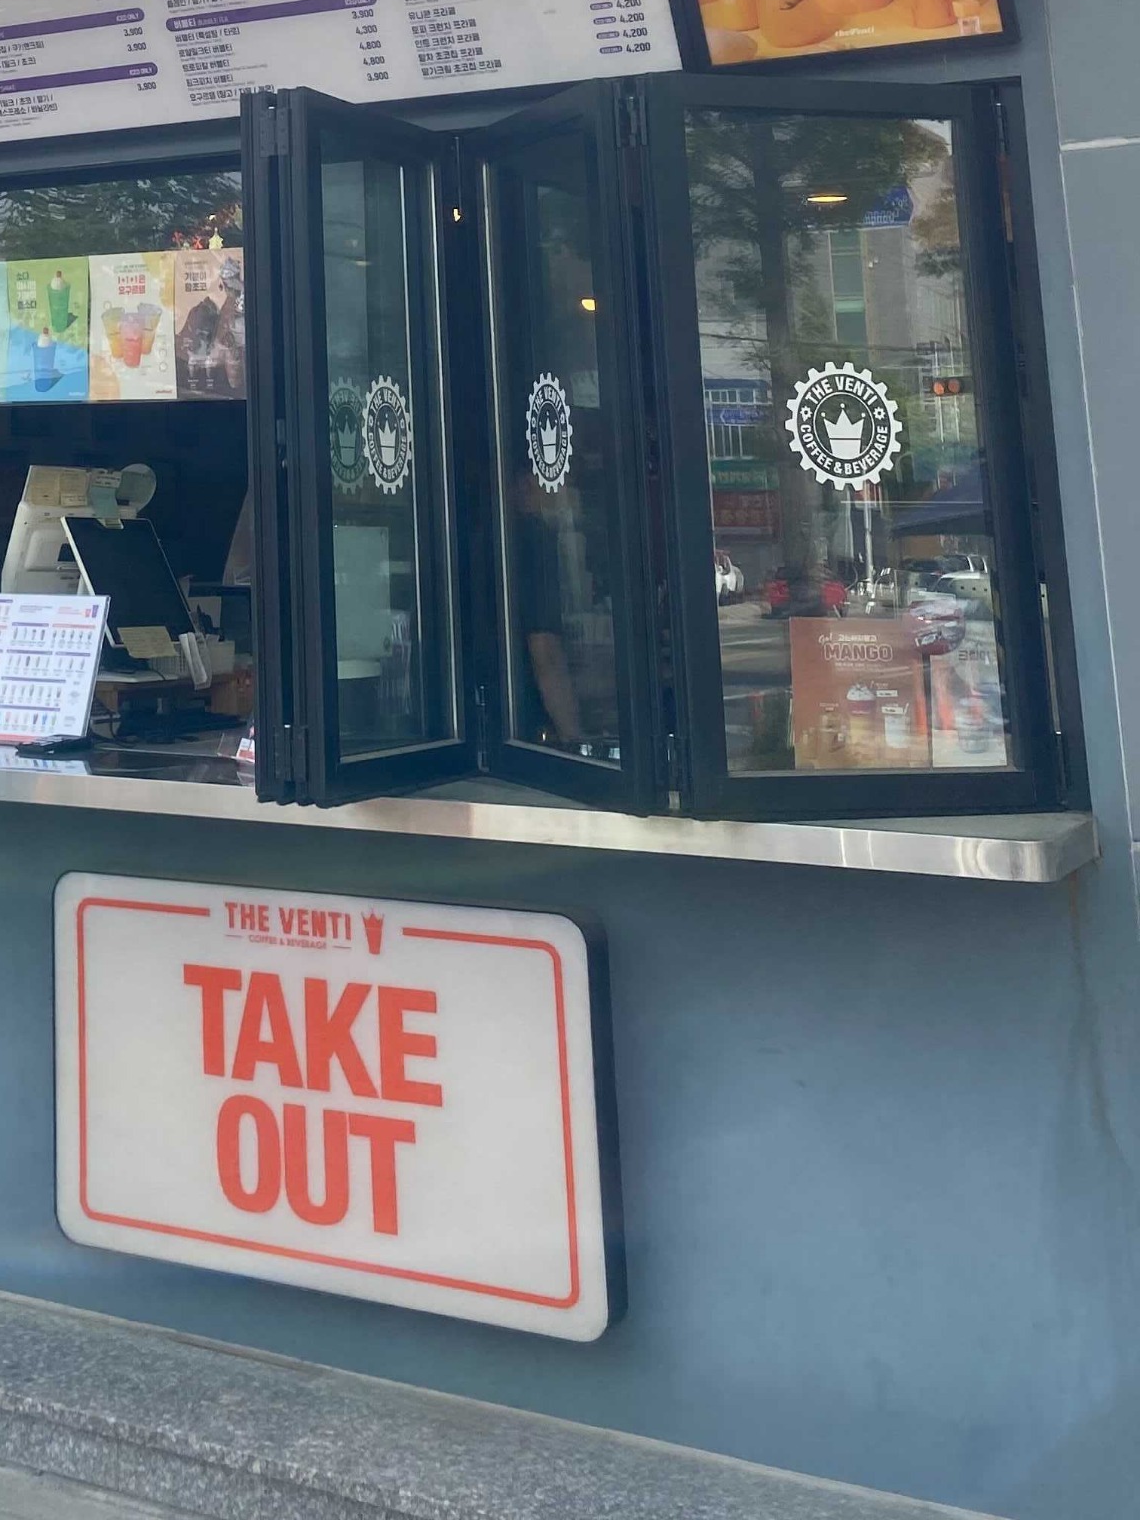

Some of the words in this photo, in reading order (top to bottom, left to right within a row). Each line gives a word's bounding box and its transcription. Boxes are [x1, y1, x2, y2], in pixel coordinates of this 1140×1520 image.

[370, 392, 383, 413] THE
[384, 388, 402, 421] VENTI
[533, 391, 544, 411] THE
[544, 387, 562, 416] VENTI
[805, 379, 832, 404] THE
[835, 377, 877, 405] VENTI
[801, 425, 833, 470] COFFEE
[834, 462, 842, 474] &
[845, 426, 887, 474] BEVERAGE
[824, 643, 893, 662] MANGO
[224, 902, 269, 932] THE
[279, 907, 351, 940] VENTI
[183, 963, 442, 1107] TAKE
[217, 1095, 416, 1236] OUT
